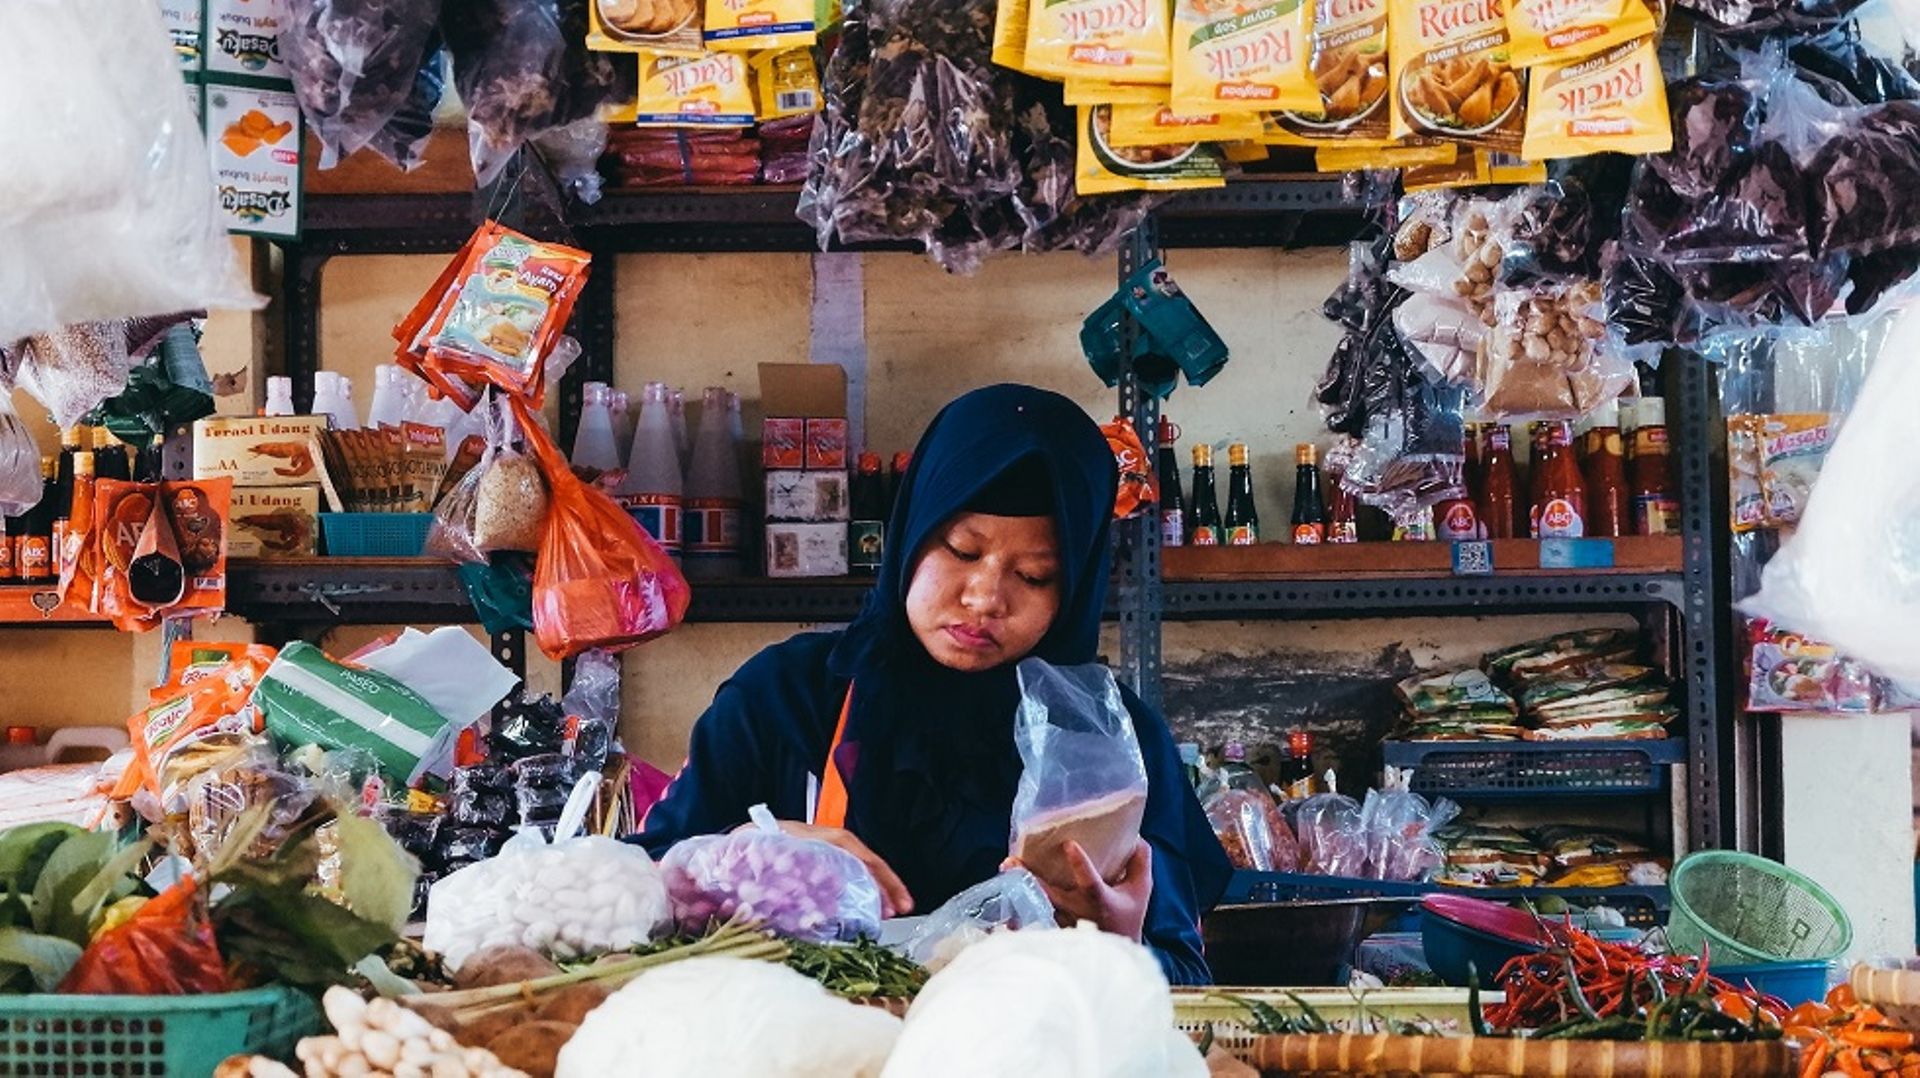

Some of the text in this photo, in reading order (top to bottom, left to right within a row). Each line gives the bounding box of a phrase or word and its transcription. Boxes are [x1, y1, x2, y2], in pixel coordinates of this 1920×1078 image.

[1059, 0, 1147, 40] Racik
[1213, 5, 1279, 35] Sayur Sop
[1419, 0, 1505, 38] Racik
[1204, 28, 1293, 80] Racik
[664, 54, 737, 97] Racik
[1557, 61, 1644, 115] Racik
[220, 190, 286, 218] Desaku
[205, 423, 311, 438] Terasi Udang
[218, 459, 239, 471] AA
[249, 494, 302, 508] Udang
[1549, 512, 1571, 524] ABC
[339, 670, 381, 695] PASEO
